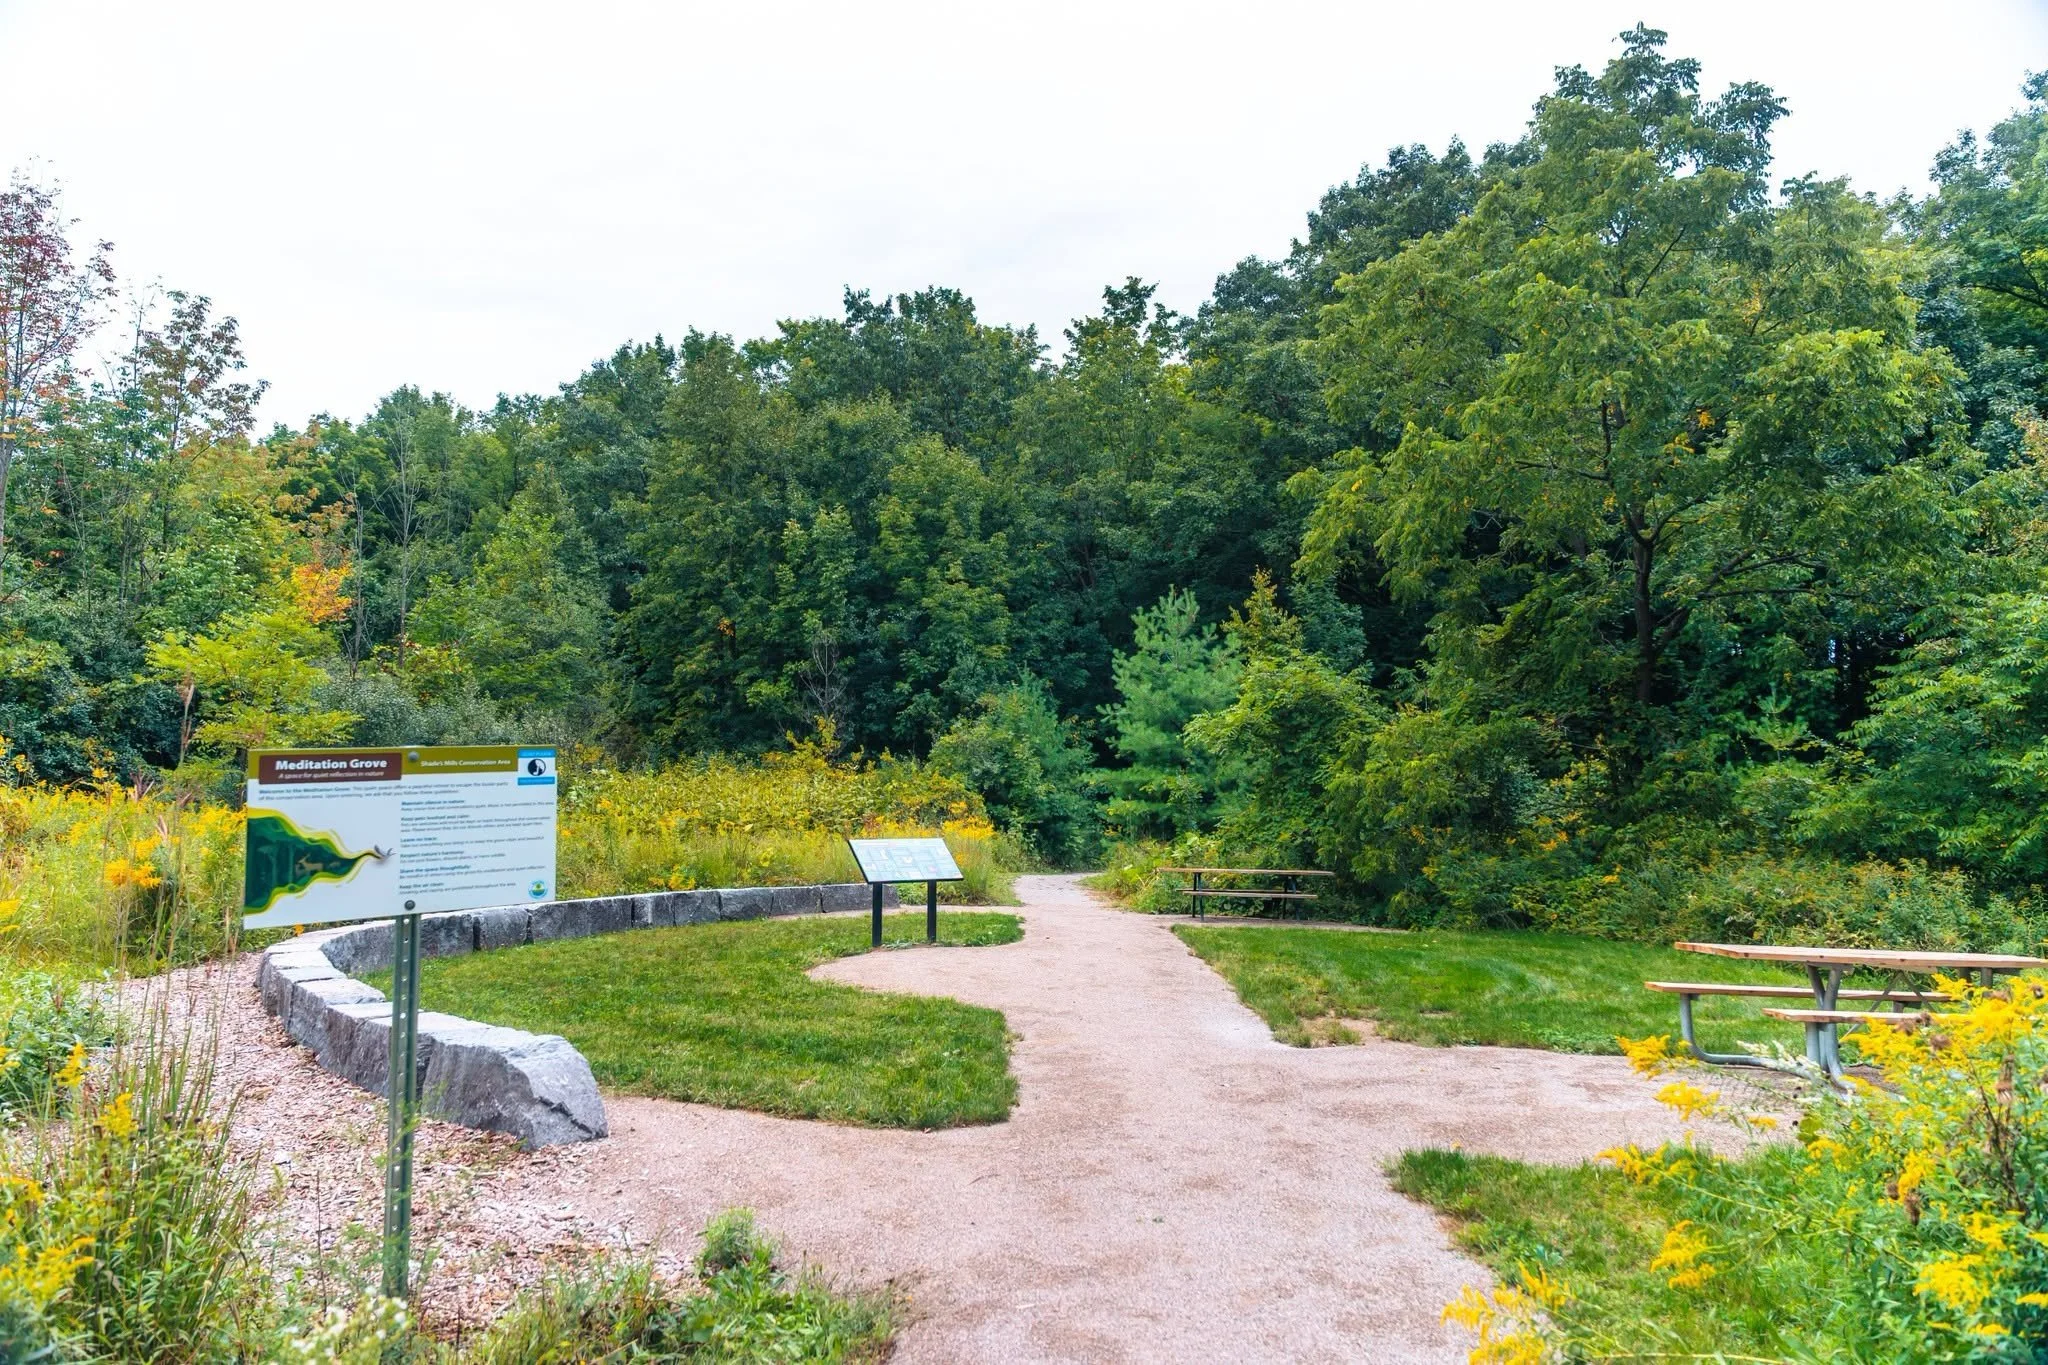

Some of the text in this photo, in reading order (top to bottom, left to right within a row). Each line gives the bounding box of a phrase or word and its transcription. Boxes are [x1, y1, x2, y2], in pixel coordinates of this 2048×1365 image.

[275, 759, 388, 770] Meditation Grove
[303, 772, 312, 780] for
